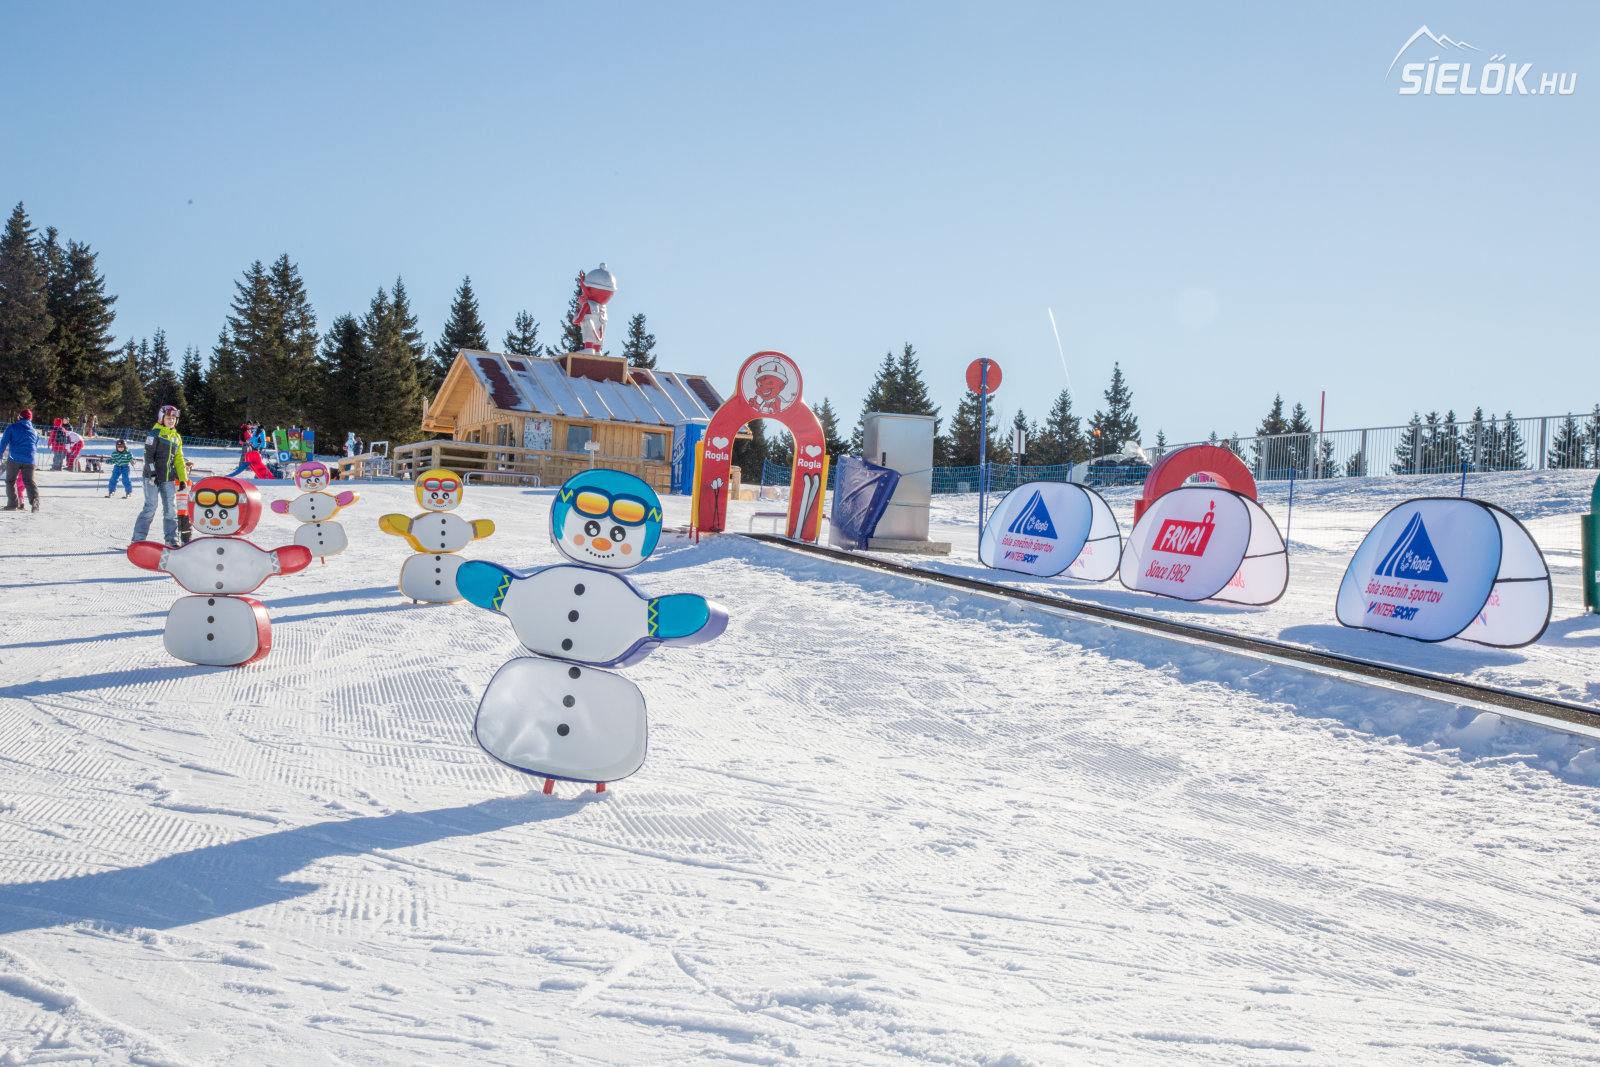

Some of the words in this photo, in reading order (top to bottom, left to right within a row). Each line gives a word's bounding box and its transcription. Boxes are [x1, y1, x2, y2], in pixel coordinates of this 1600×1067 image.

[705, 450, 729, 462] Rogla
[797, 458, 822, 470] Rogla
[1034, 519, 1049, 533] Rogla
[1160, 524, 1206, 553] FRUPI
[1008, 552, 1039, 564] INTERSPORT
[1410, 555, 1432, 573] Rogla
[1145, 559, 1168, 580] Since
[1166, 563, 1192, 583] 1962
[1365, 578, 1381, 595] šola
[1380, 582, 1408, 599] snežnih
[1407, 583, 1444, 604] športov
[1372, 602, 1420, 621] INTERSPORT
